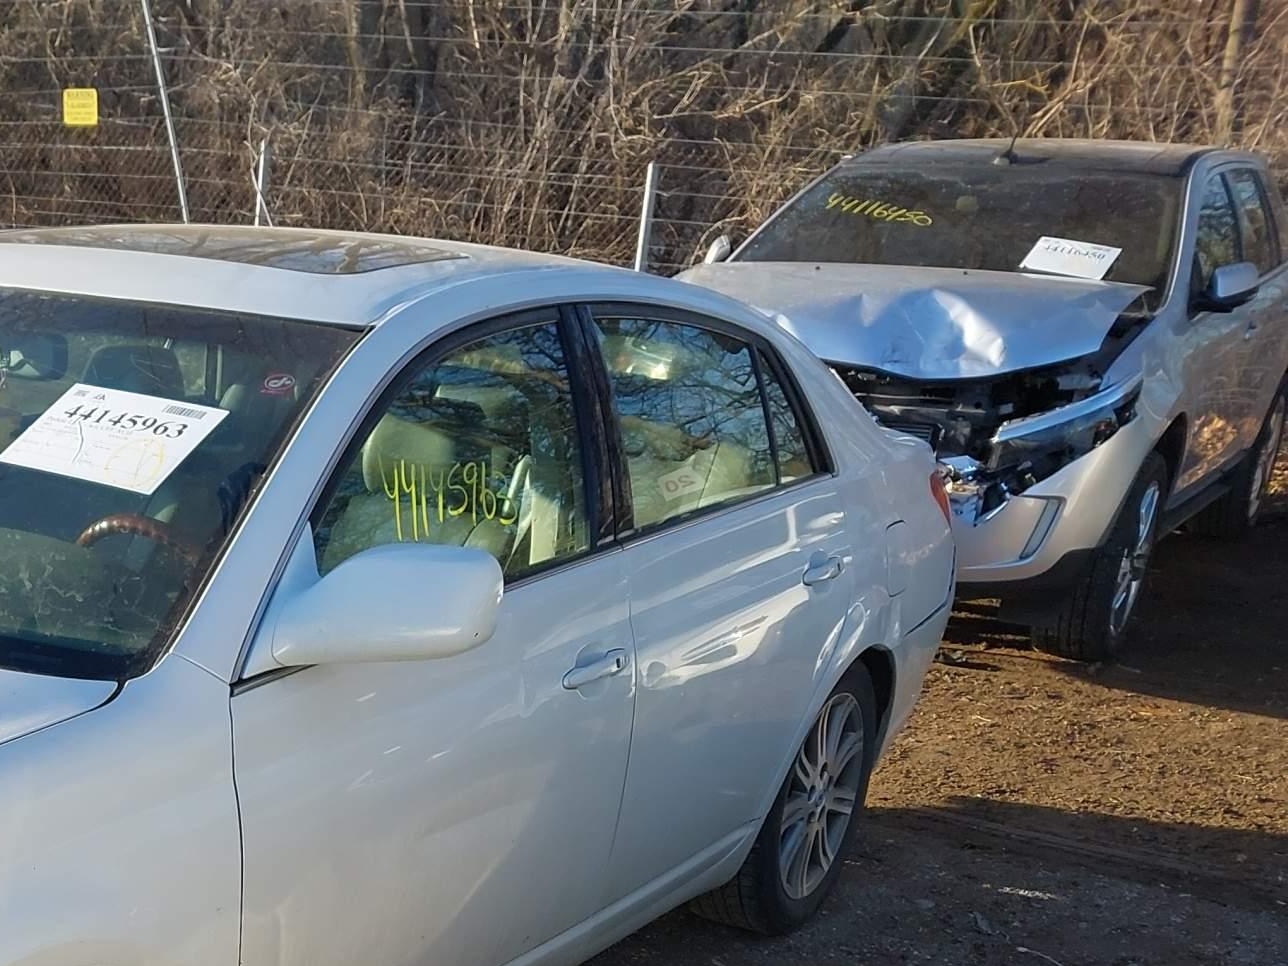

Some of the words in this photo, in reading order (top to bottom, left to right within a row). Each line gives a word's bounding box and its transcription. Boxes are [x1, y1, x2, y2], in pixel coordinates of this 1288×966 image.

[825, 193, 932, 226] 44116450
[64, 405, 189, 439] 44145963
[378, 454, 518, 541] 44145963
